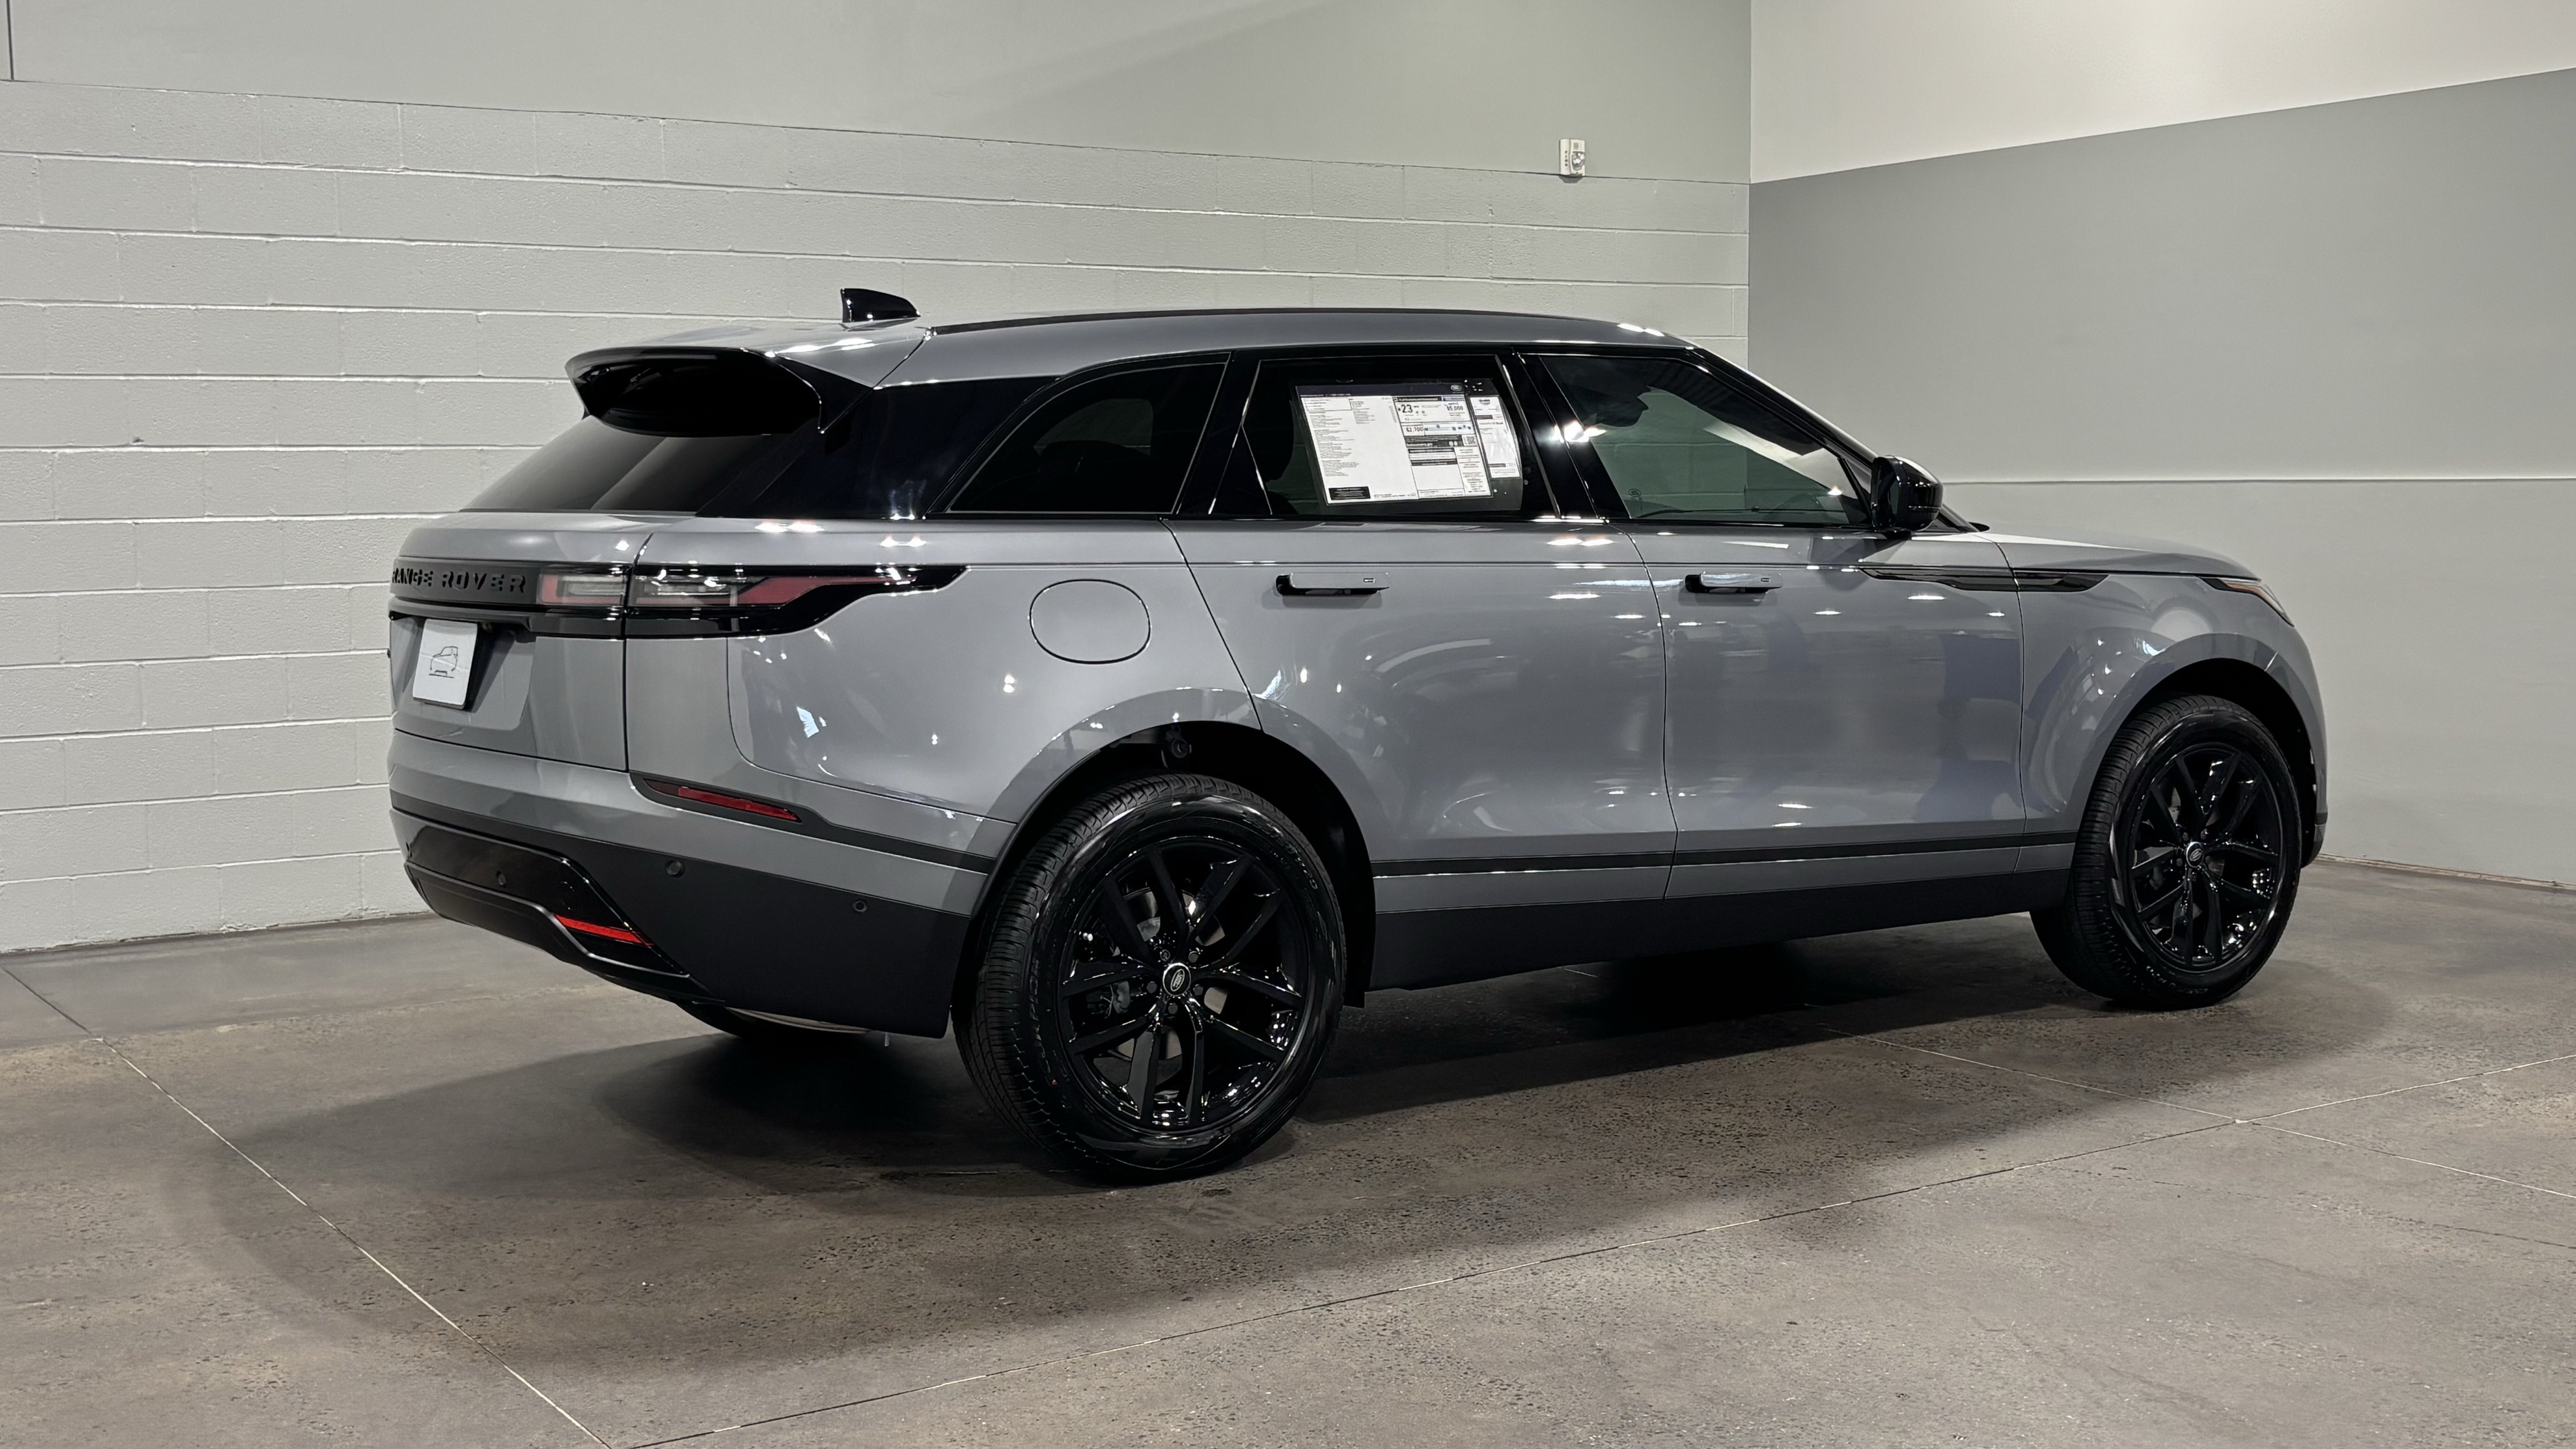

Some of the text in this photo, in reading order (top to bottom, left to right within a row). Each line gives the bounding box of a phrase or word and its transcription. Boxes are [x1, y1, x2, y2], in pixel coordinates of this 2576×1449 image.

[1401, 404, 1413, 413] 23
[392, 568, 526, 593] RANGE ROVER
